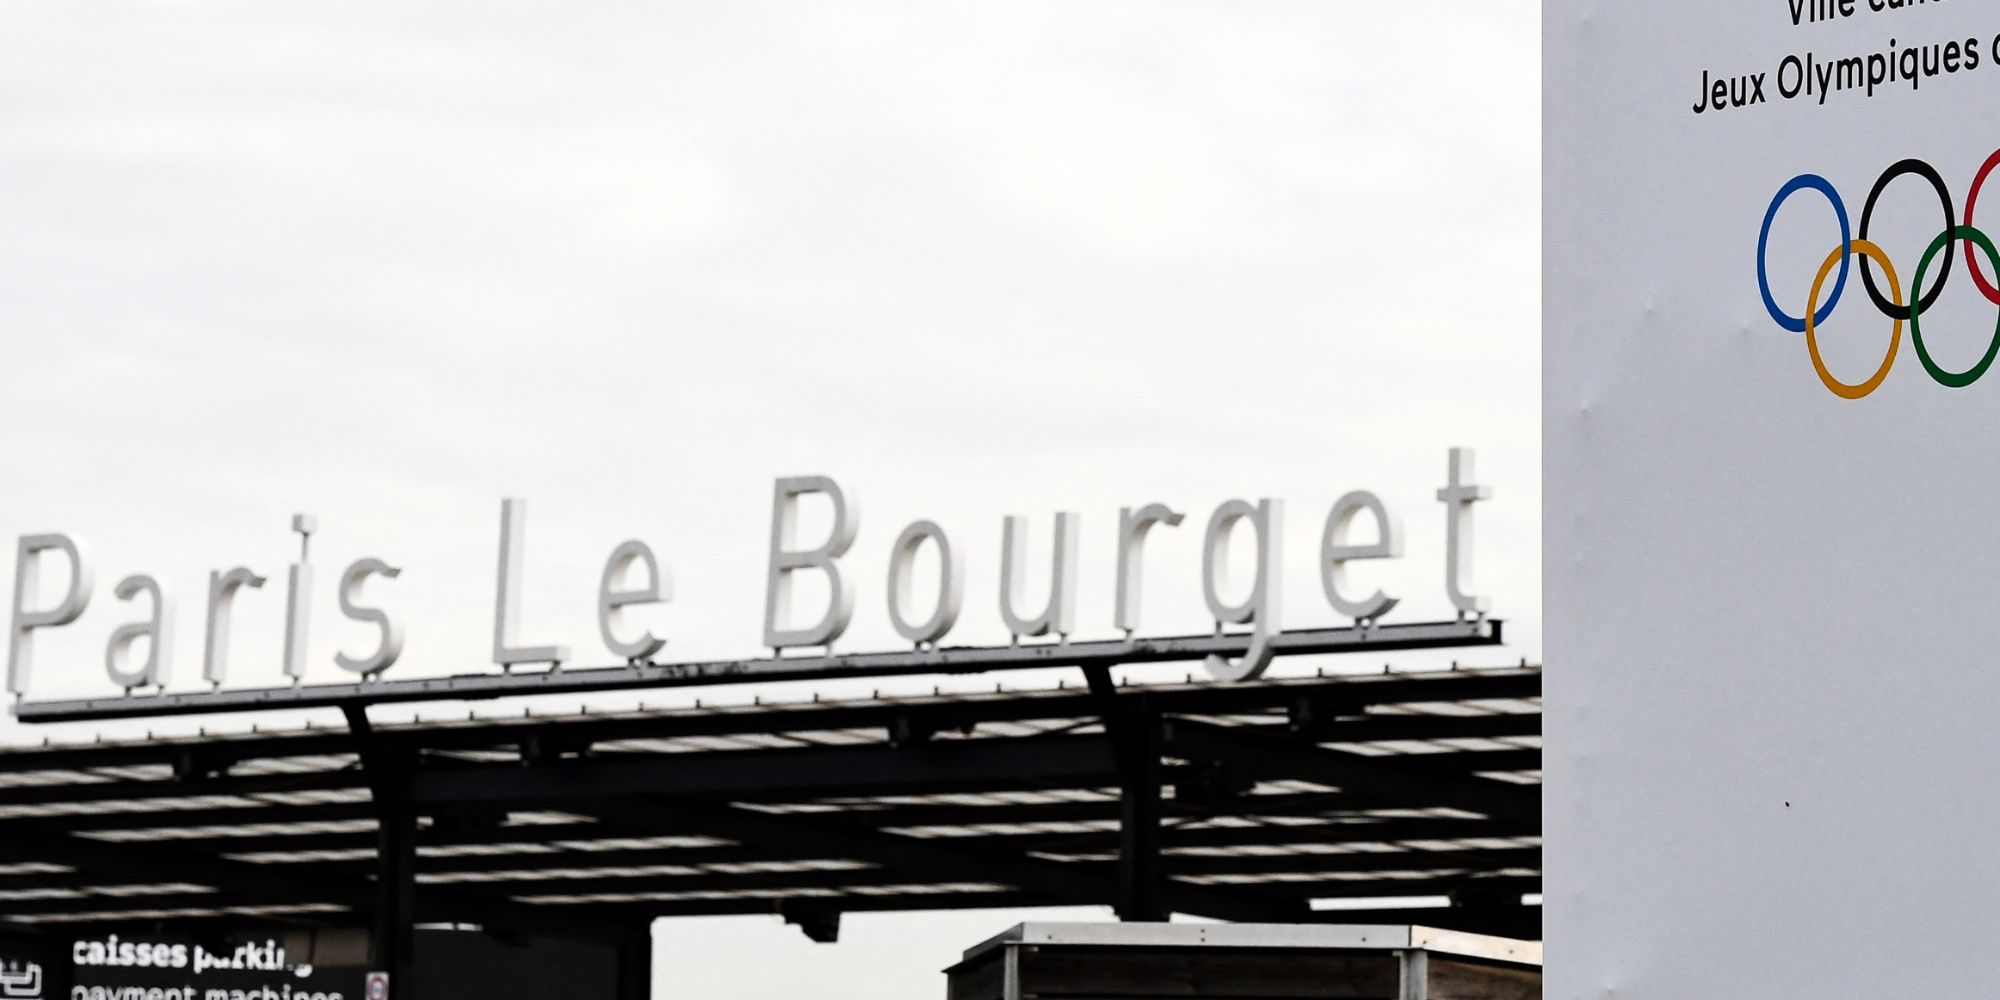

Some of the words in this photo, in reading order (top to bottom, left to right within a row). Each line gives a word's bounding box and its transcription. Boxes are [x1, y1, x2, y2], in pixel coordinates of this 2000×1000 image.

[1692, 70, 1766, 114] Jeux
[1777, 37, 1980, 105] Olympiques
[6, 512, 404, 695] Paris
[494, 497, 673, 666] Le
[763, 446, 1493, 682] Bourget
[73, 934, 188, 968] caisses
